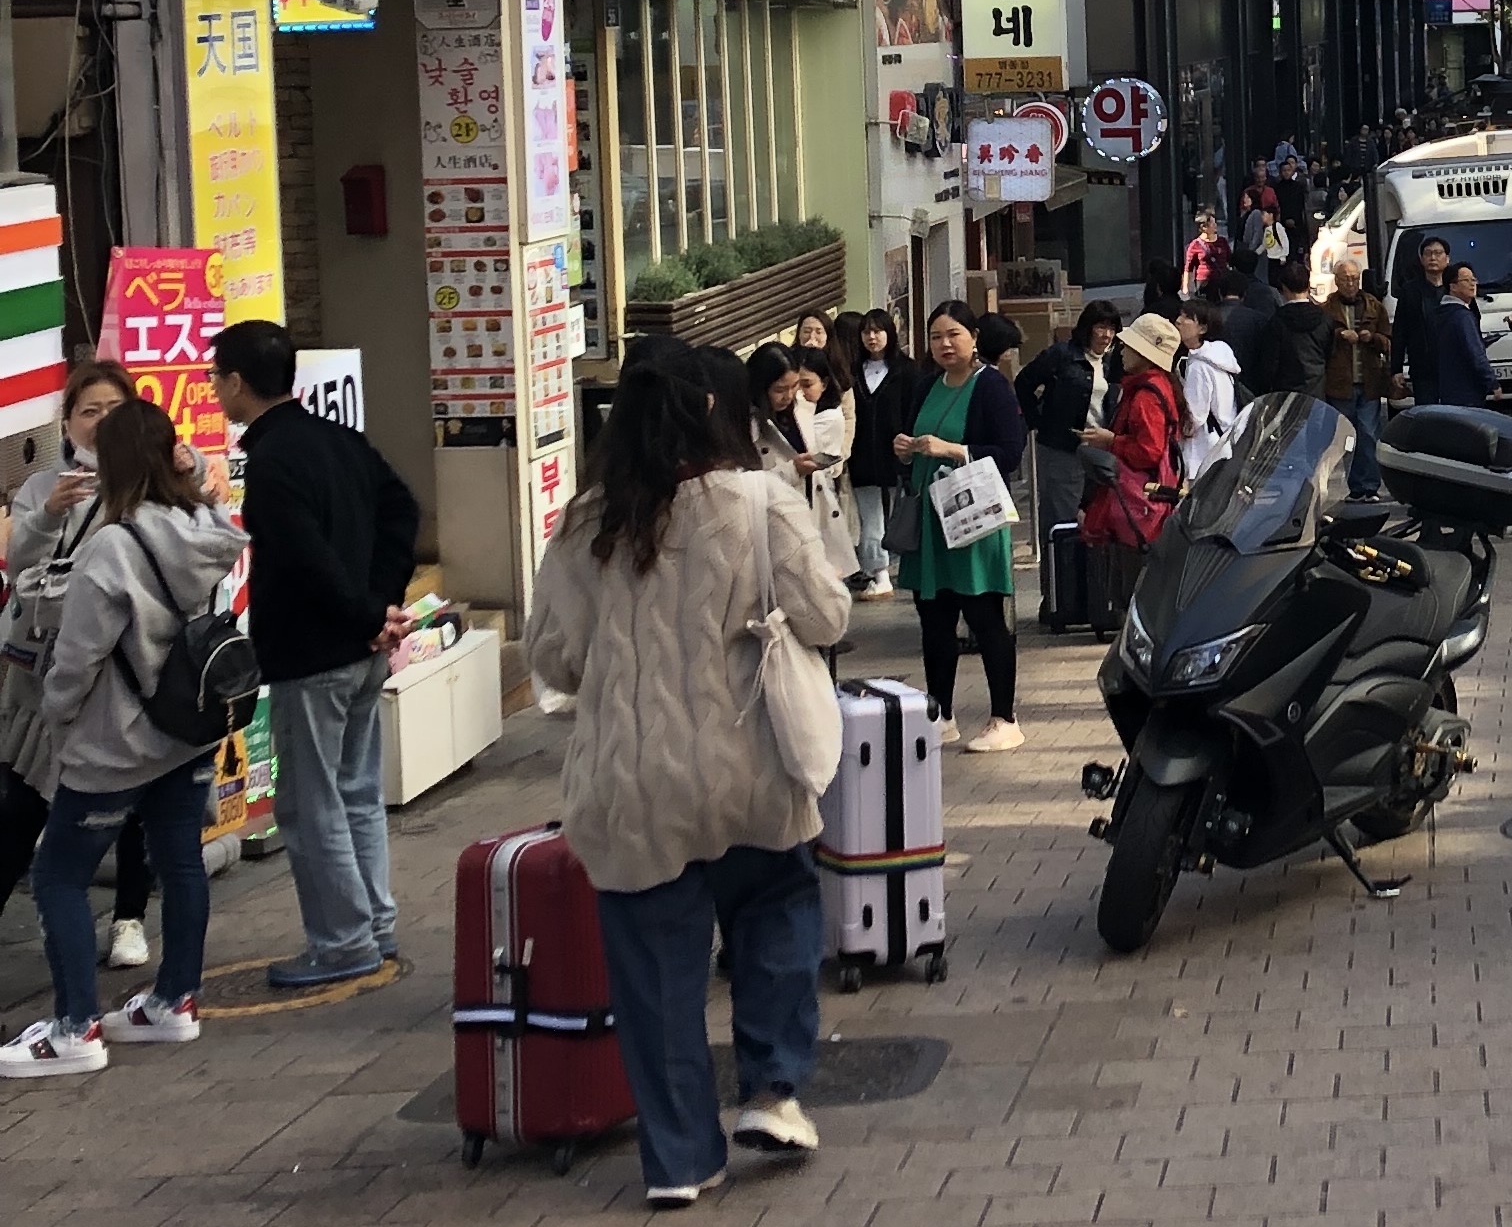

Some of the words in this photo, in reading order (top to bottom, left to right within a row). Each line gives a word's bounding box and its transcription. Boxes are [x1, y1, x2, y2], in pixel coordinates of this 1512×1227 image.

[196, 9, 260, 78] 天国
[975, 71, 1054, 89] 777-3231
[1093, 87, 1148, 153] 약
[124, 271, 186, 312] ベラ
